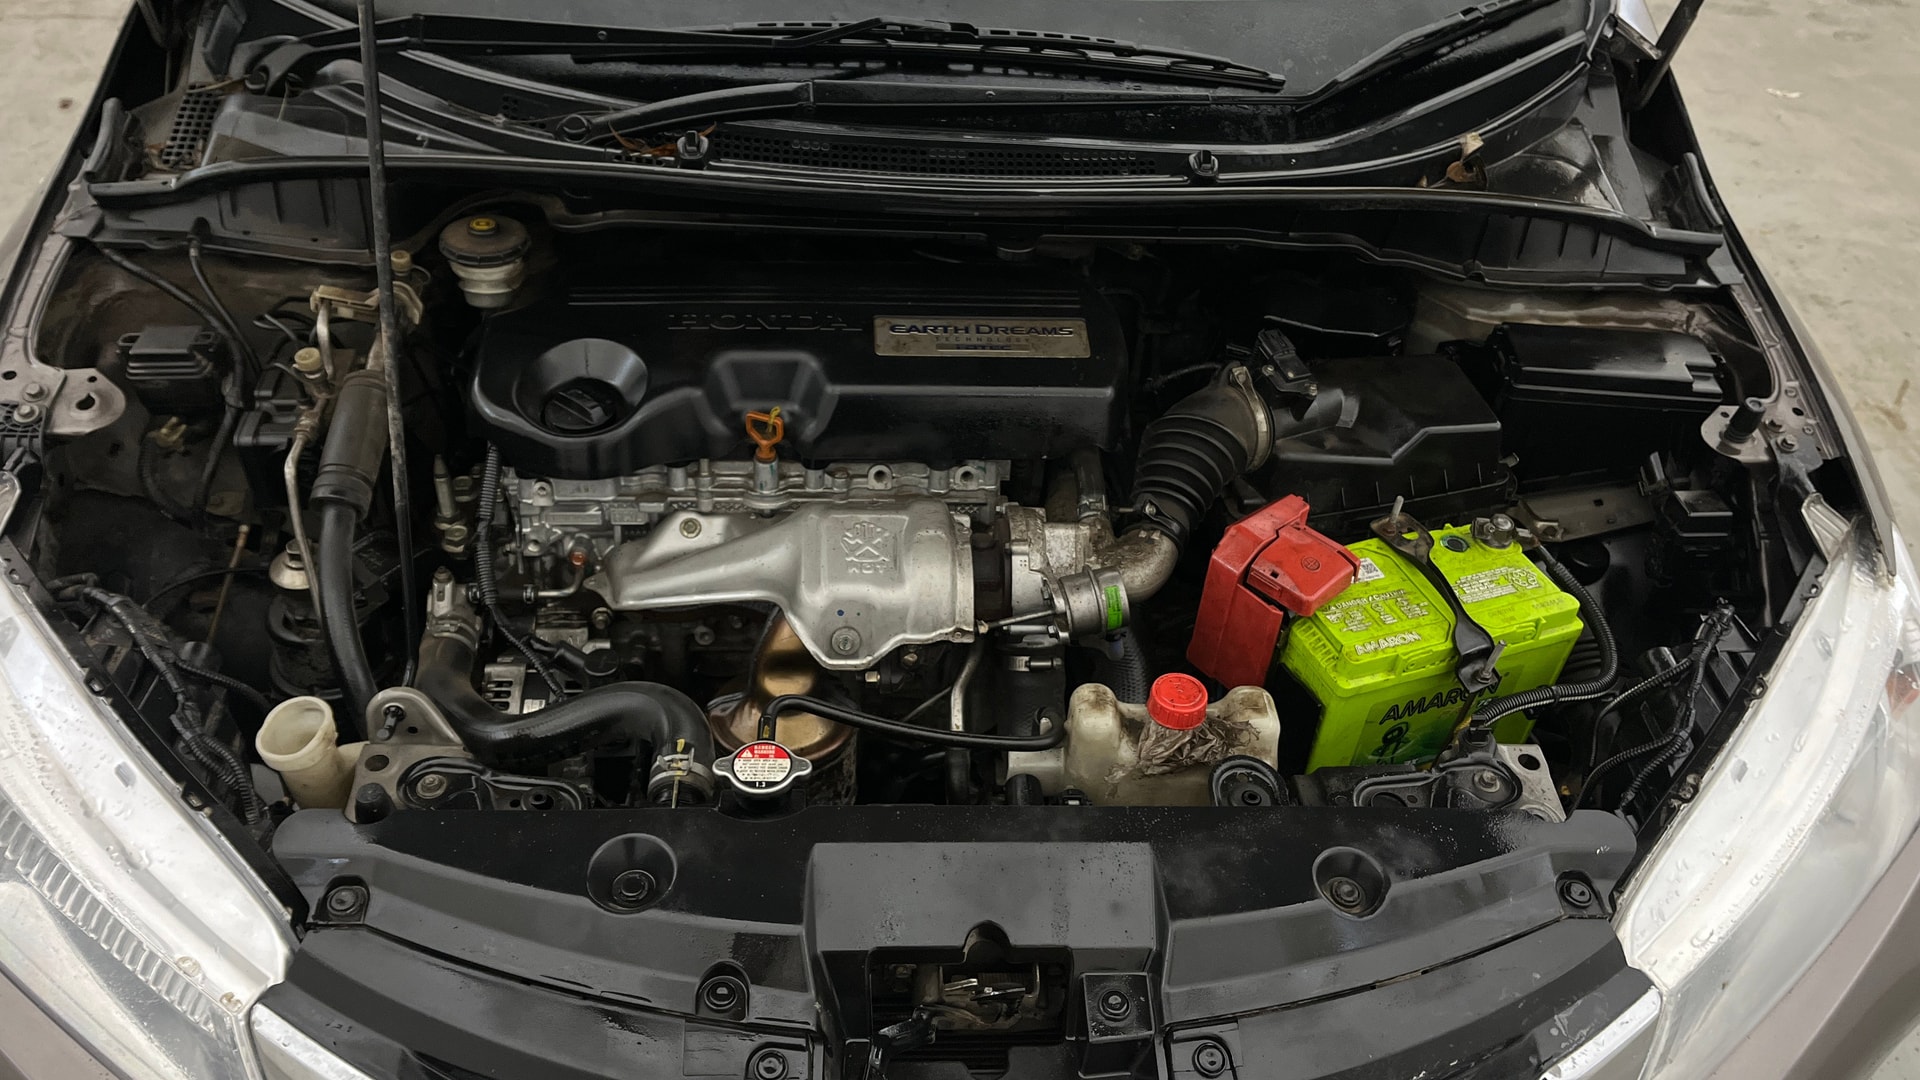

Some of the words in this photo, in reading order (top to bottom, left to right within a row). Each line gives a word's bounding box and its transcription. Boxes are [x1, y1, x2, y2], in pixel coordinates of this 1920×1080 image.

[667, 315, 863, 331] HONDA
[889, 324, 969, 336] EARTH
[1354, 631, 1422, 656] AMARON
